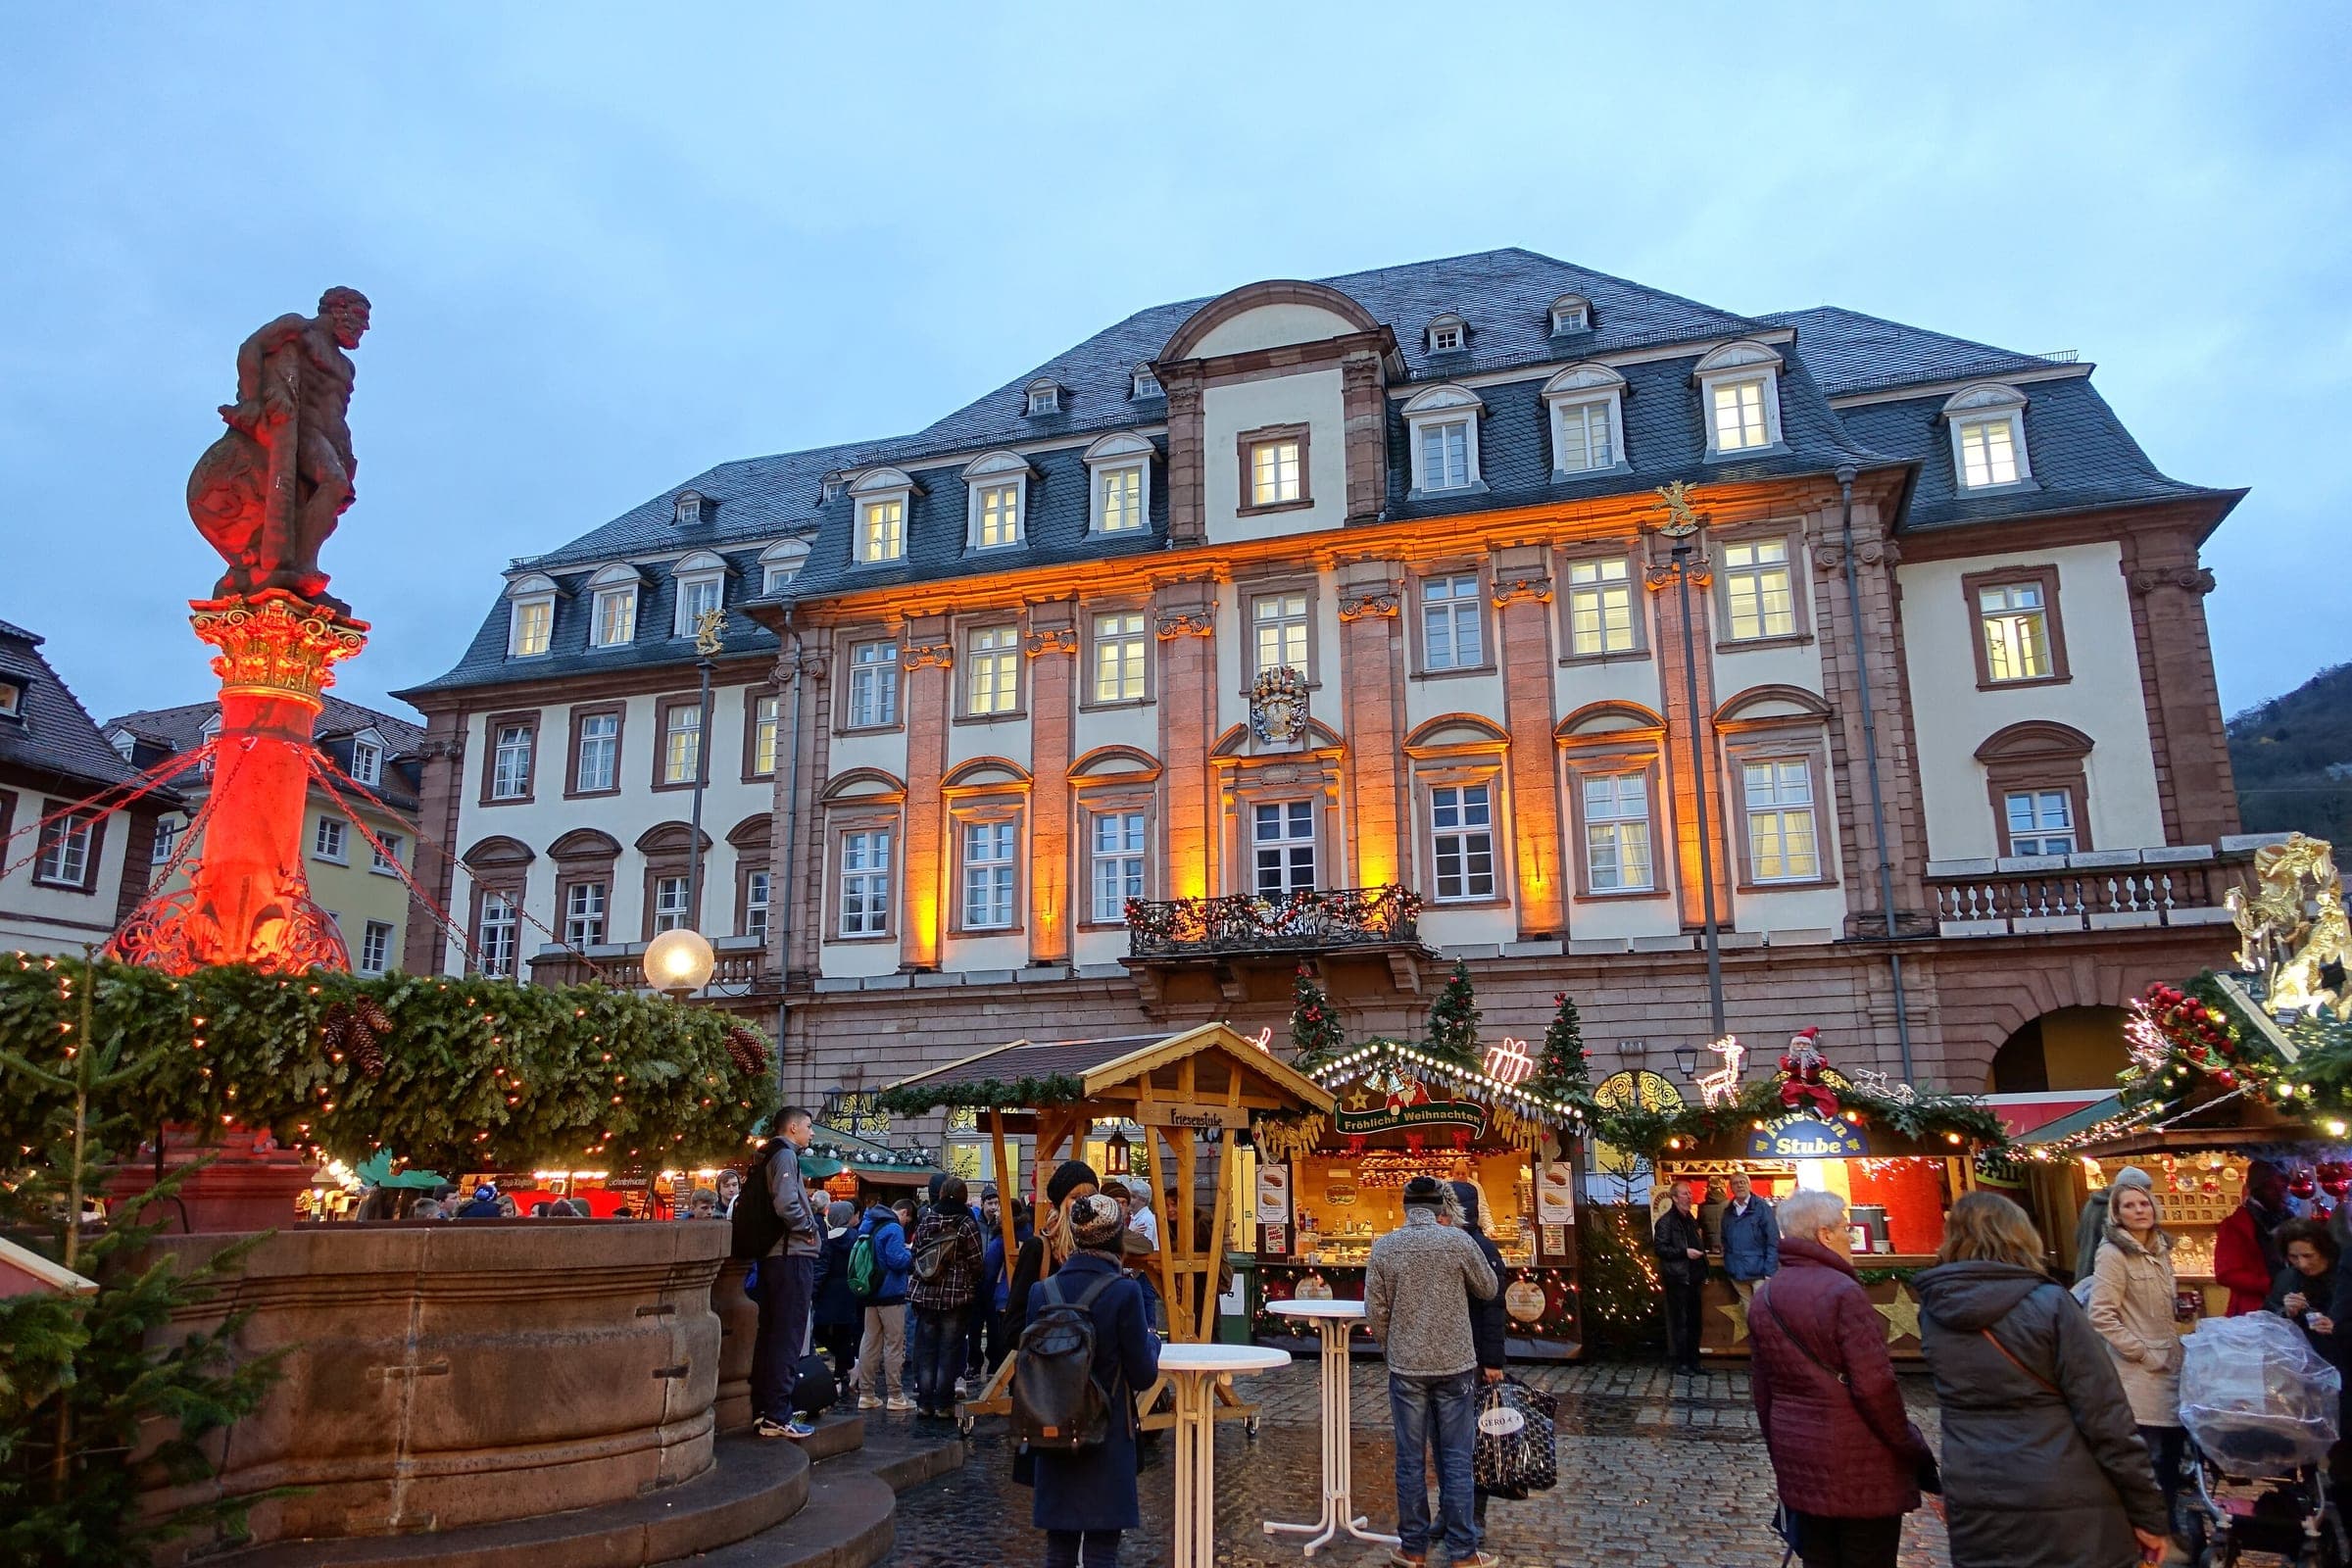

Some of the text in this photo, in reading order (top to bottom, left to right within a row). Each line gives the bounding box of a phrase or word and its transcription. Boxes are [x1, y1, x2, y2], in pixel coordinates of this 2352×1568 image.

[1170, 1107, 1223, 1127] Friesenstube
[1345, 1110, 1481, 1130] Fröhliche Weihnachten
[1775, 1137, 1841, 1154] Stube
